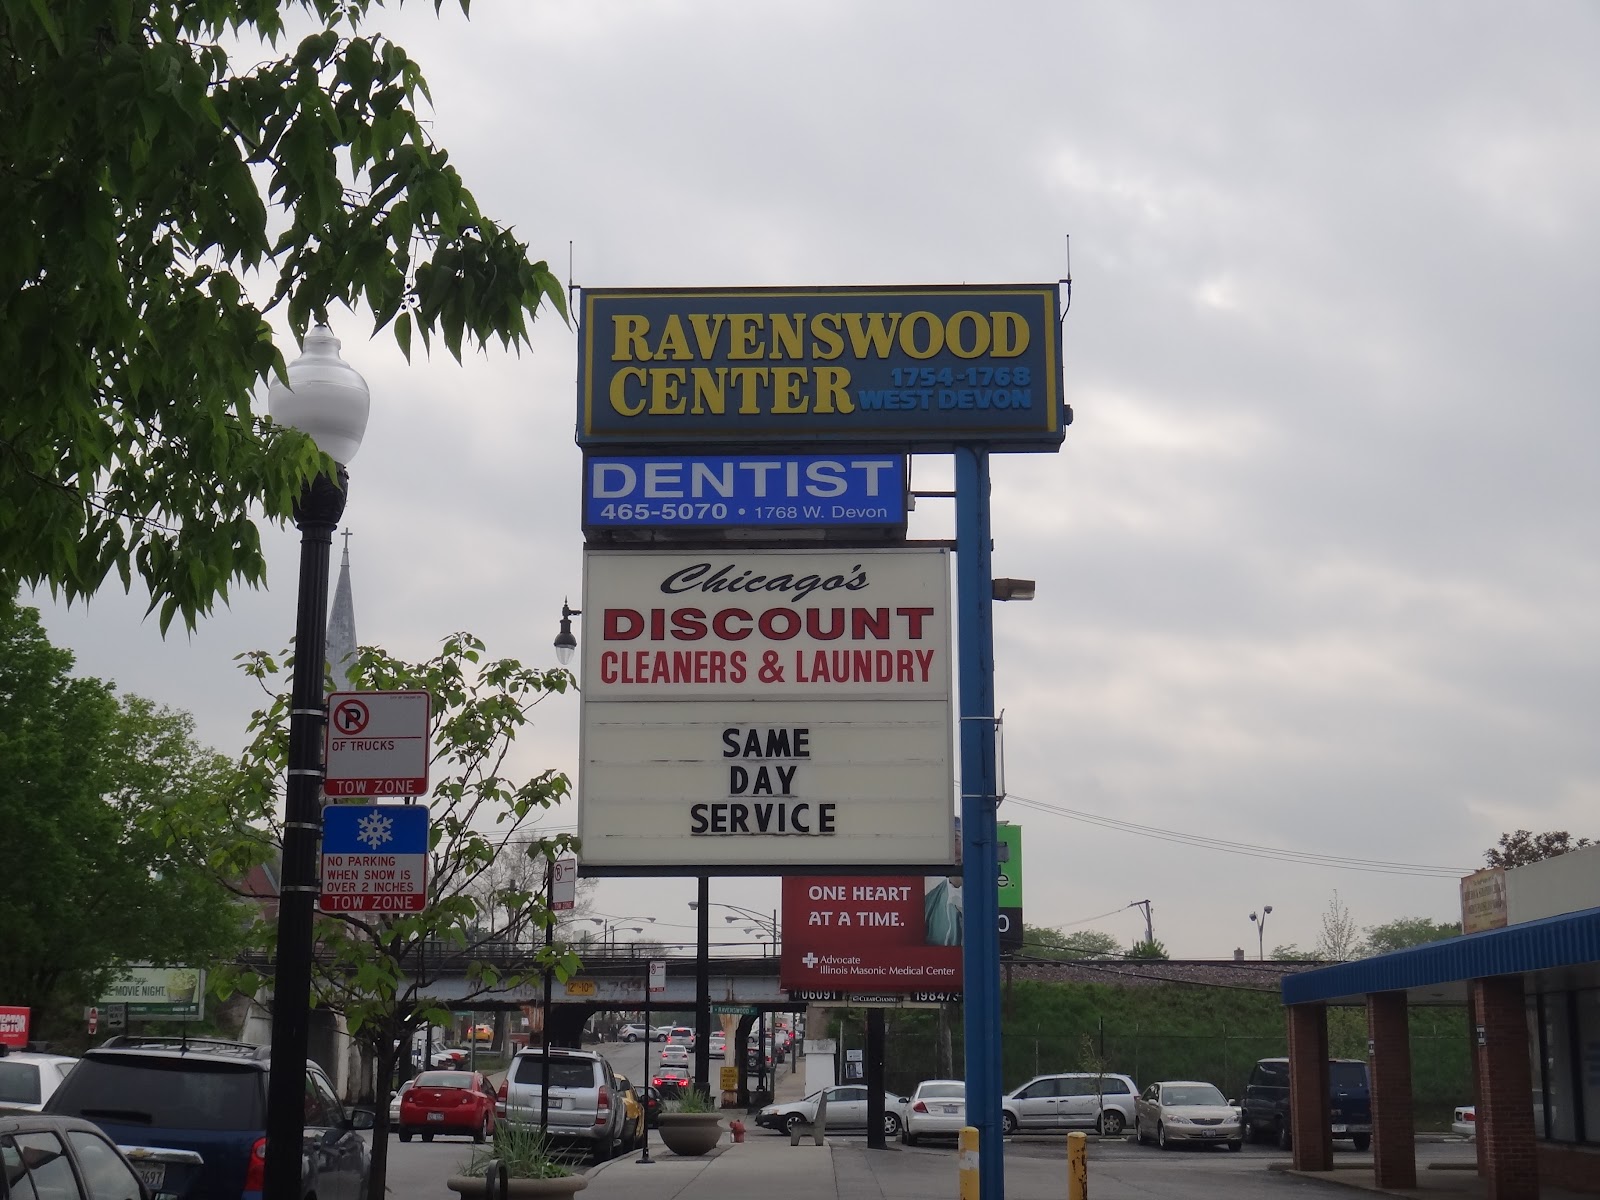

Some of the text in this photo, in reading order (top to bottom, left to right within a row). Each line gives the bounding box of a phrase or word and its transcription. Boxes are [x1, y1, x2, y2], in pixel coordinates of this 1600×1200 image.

[610, 310, 1031, 361] RAVENSWOOD
[891, 367, 1031, 388] 1754-1768
[609, 366, 855, 417] CENTER
[858, 389, 1032, 411] WEST DEVON
[592, 460, 894, 499] DENTIST
[600, 503, 888, 520] 465-5070 1768 W. Devon
[659, 562, 870, 603] Chicago's
[603, 607, 935, 641] DISCOUNT
[601, 649, 935, 684] CLEANERS & LAUNDRY
[332, 740, 395, 751] OF TRUCKS
[722, 727, 811, 758] SAME
[336, 780, 415, 794] TOW ZONE
[729, 765, 798, 795] DAY
[690, 802, 836, 833] SERVICE
[327, 856, 396, 867] NO PARKING
[327, 870, 411, 880] WHEN SNOW IS
[327, 882, 414, 892] OVER 2 INCHES
[808, 885, 912, 901] ONE HEART
[332, 896, 414, 909] TOW ZONE
[808, 911, 905, 927] AT A TIME.
[820, 955, 861, 965] Advocate
[820, 965, 956, 976] Illinois Masonic Medical Center
[115, 986, 140, 997] MOVIE
[141, 986, 166, 997] NIGHT.
